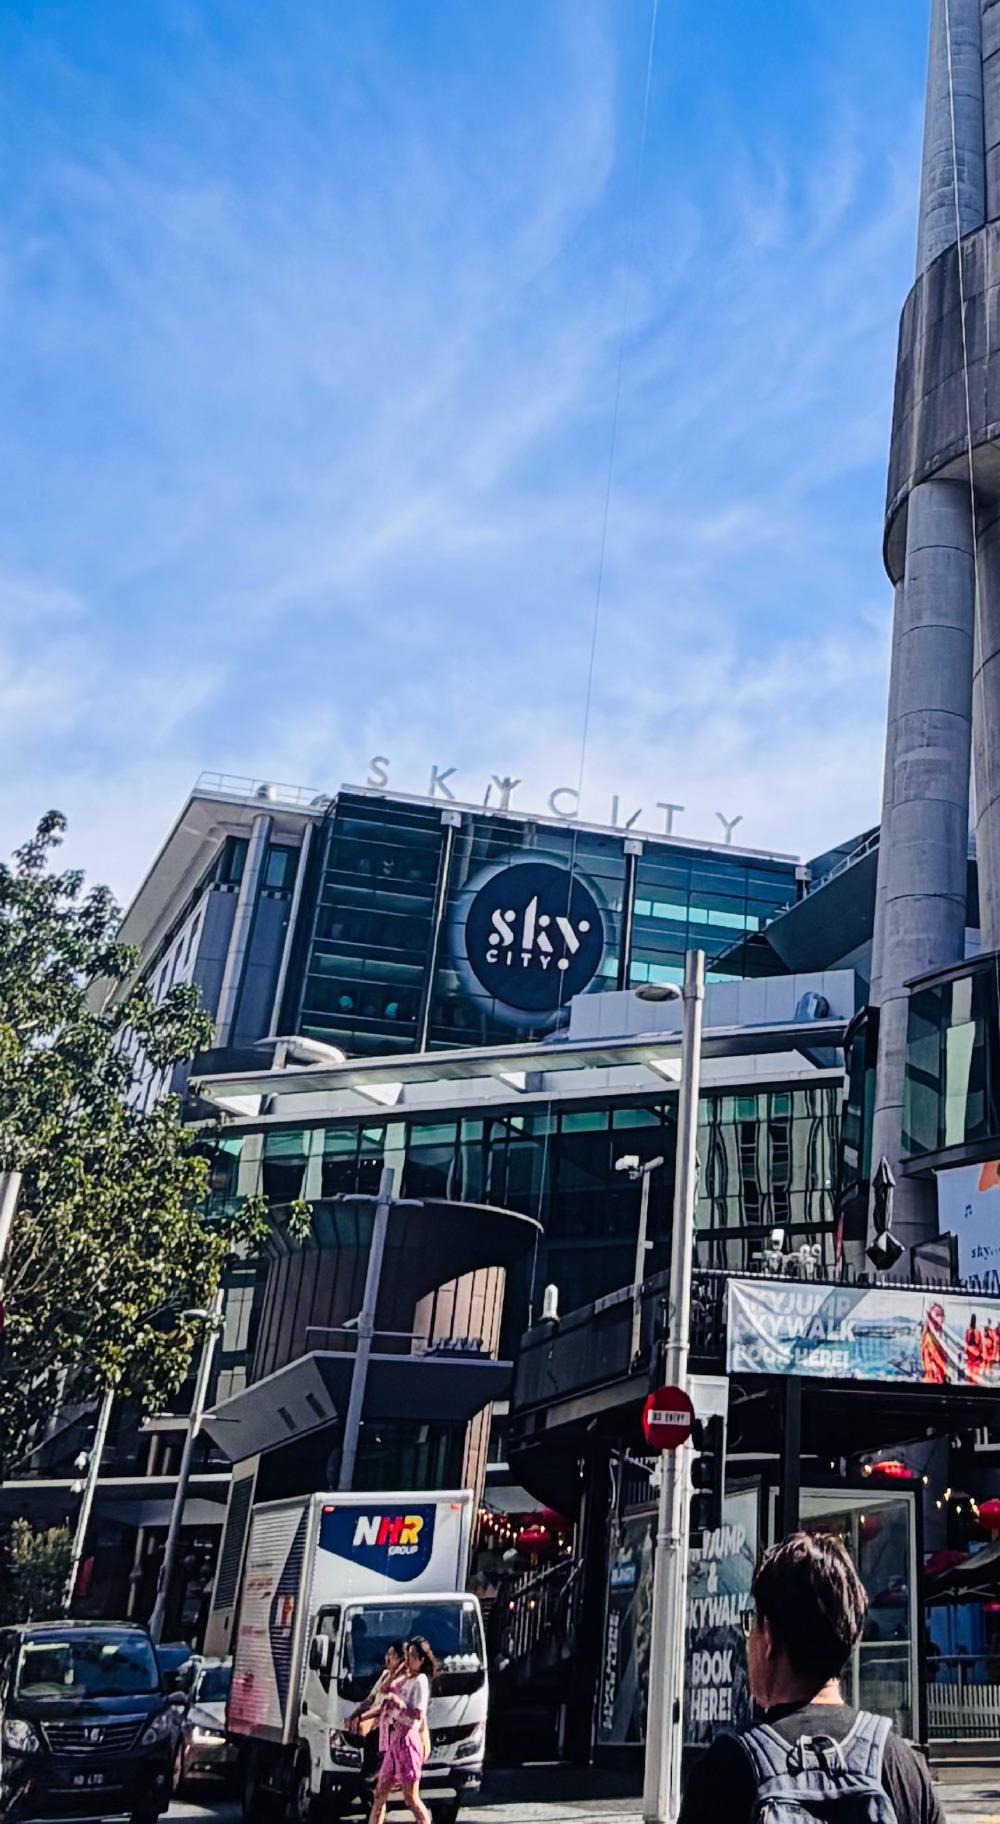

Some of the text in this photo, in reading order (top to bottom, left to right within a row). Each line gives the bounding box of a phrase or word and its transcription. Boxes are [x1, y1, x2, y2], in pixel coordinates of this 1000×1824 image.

[366, 755, 743, 844] SKYCITY
[488, 895, 590, 970] sky
[486, 948, 552, 970] CITY
[352, 1515, 424, 1547] NHR
[388, 1545, 419, 1556] GROUP
[688, 1592, 750, 1629] KYWALK
[691, 1650, 733, 1685] BOOK
[690, 1687, 732, 1721] HERE!
